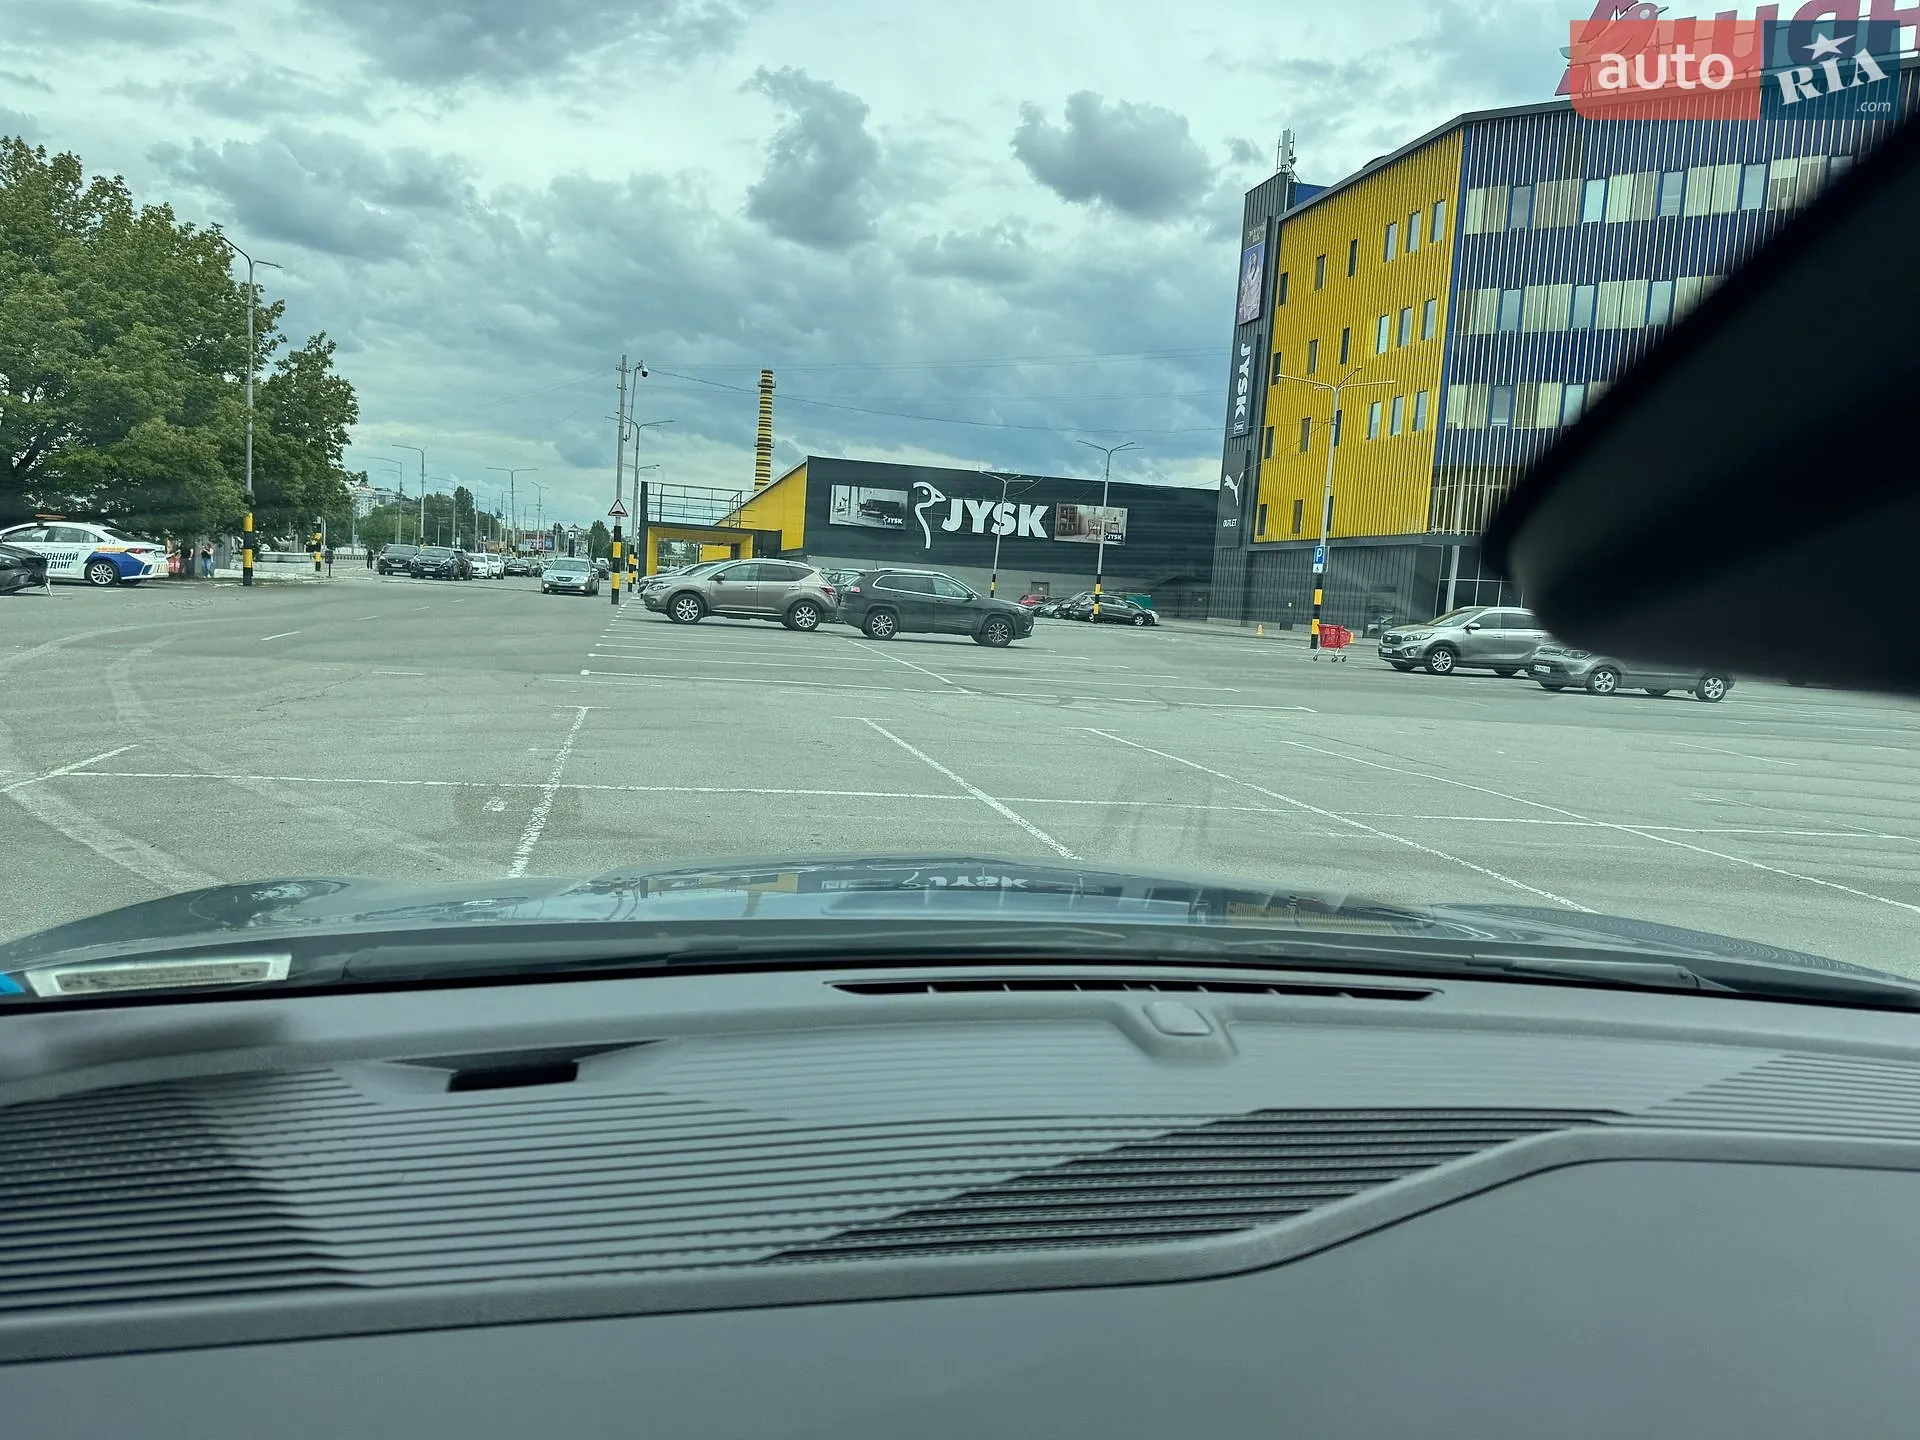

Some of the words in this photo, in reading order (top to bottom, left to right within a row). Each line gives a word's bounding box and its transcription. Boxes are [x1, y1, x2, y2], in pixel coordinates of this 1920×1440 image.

[1234, 342, 1251, 420] JYSK
[886, 517, 903, 525] JYSK
[941, 498, 1049, 539] JYSK
[1222, 518, 1238, 528] OUTLET
[1106, 533, 1122, 541] JYSK
[36, 551, 79, 561] РОННИЙ
[1316, 548, 1323, 562] P
[47, 561, 73, 570] ДІНГ
